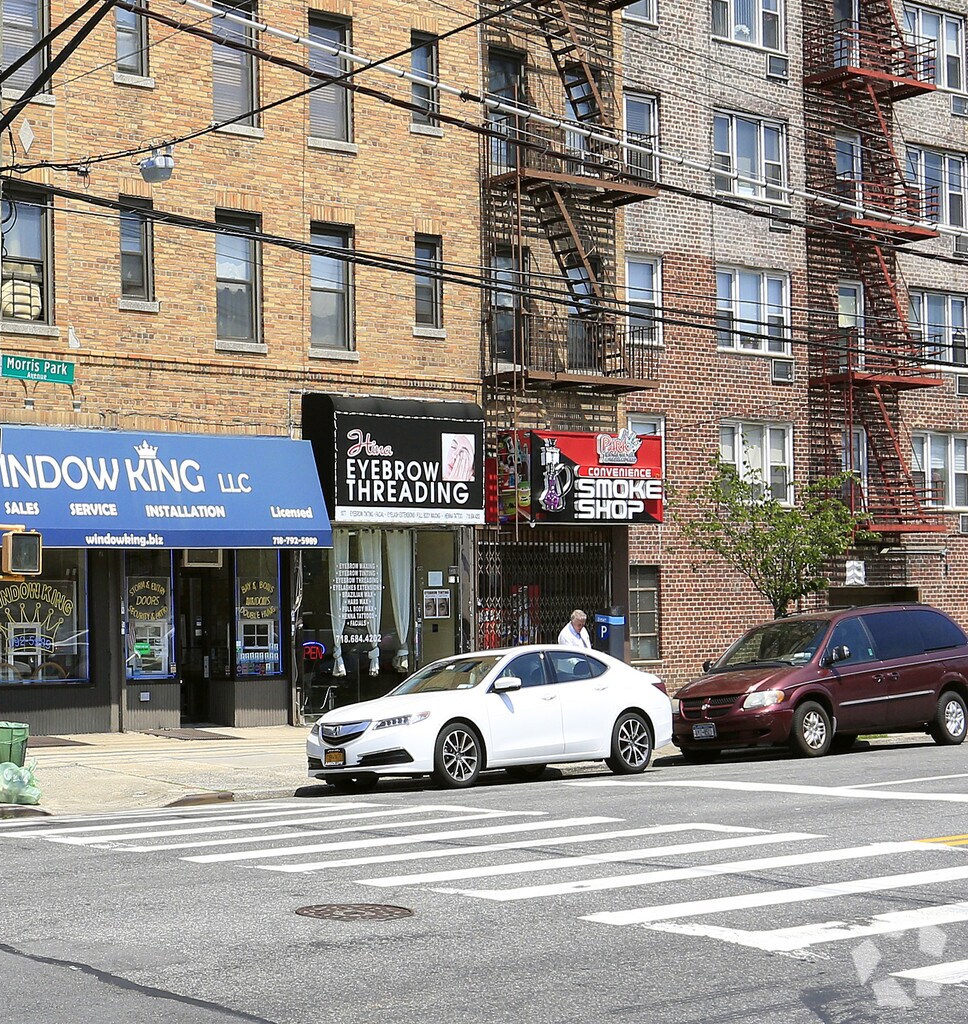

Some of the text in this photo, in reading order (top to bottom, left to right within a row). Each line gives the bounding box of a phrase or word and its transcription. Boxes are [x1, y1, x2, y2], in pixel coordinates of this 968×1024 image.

[7, 357, 68, 375] Morris Park
[27, 372, 48, 380] Avenue
[124, 458, 206, 493] KING
[217, 473, 253, 494] LLC
[346, 458, 440, 482] EYEBROW
[588, 467, 652, 478] CONVENIENCE
[346, 479, 470, 504] THREADING
[575, 479, 663, 499] SMOKE
[4, 501, 40, 516] SALES
[69, 502, 118, 517] SERVICE
[145, 504, 226, 518] INSTALLATION
[270, 505, 314, 519] Licensed
[575, 499, 645, 520] SHOP
[85, 532, 164, 546] windowking.biz
[272, 536, 318, 545] 718-792-5989
[339, 562, 358, 570] EYEBROW
[240, 581, 251, 594] BAY
[41, 583, 74, 617] KING
[135, 595, 160, 606] DOORS
[239, 606, 260, 620] DOUBLE
[601, 625, 608, 638] P
[303, 646, 324, 660] PEN
